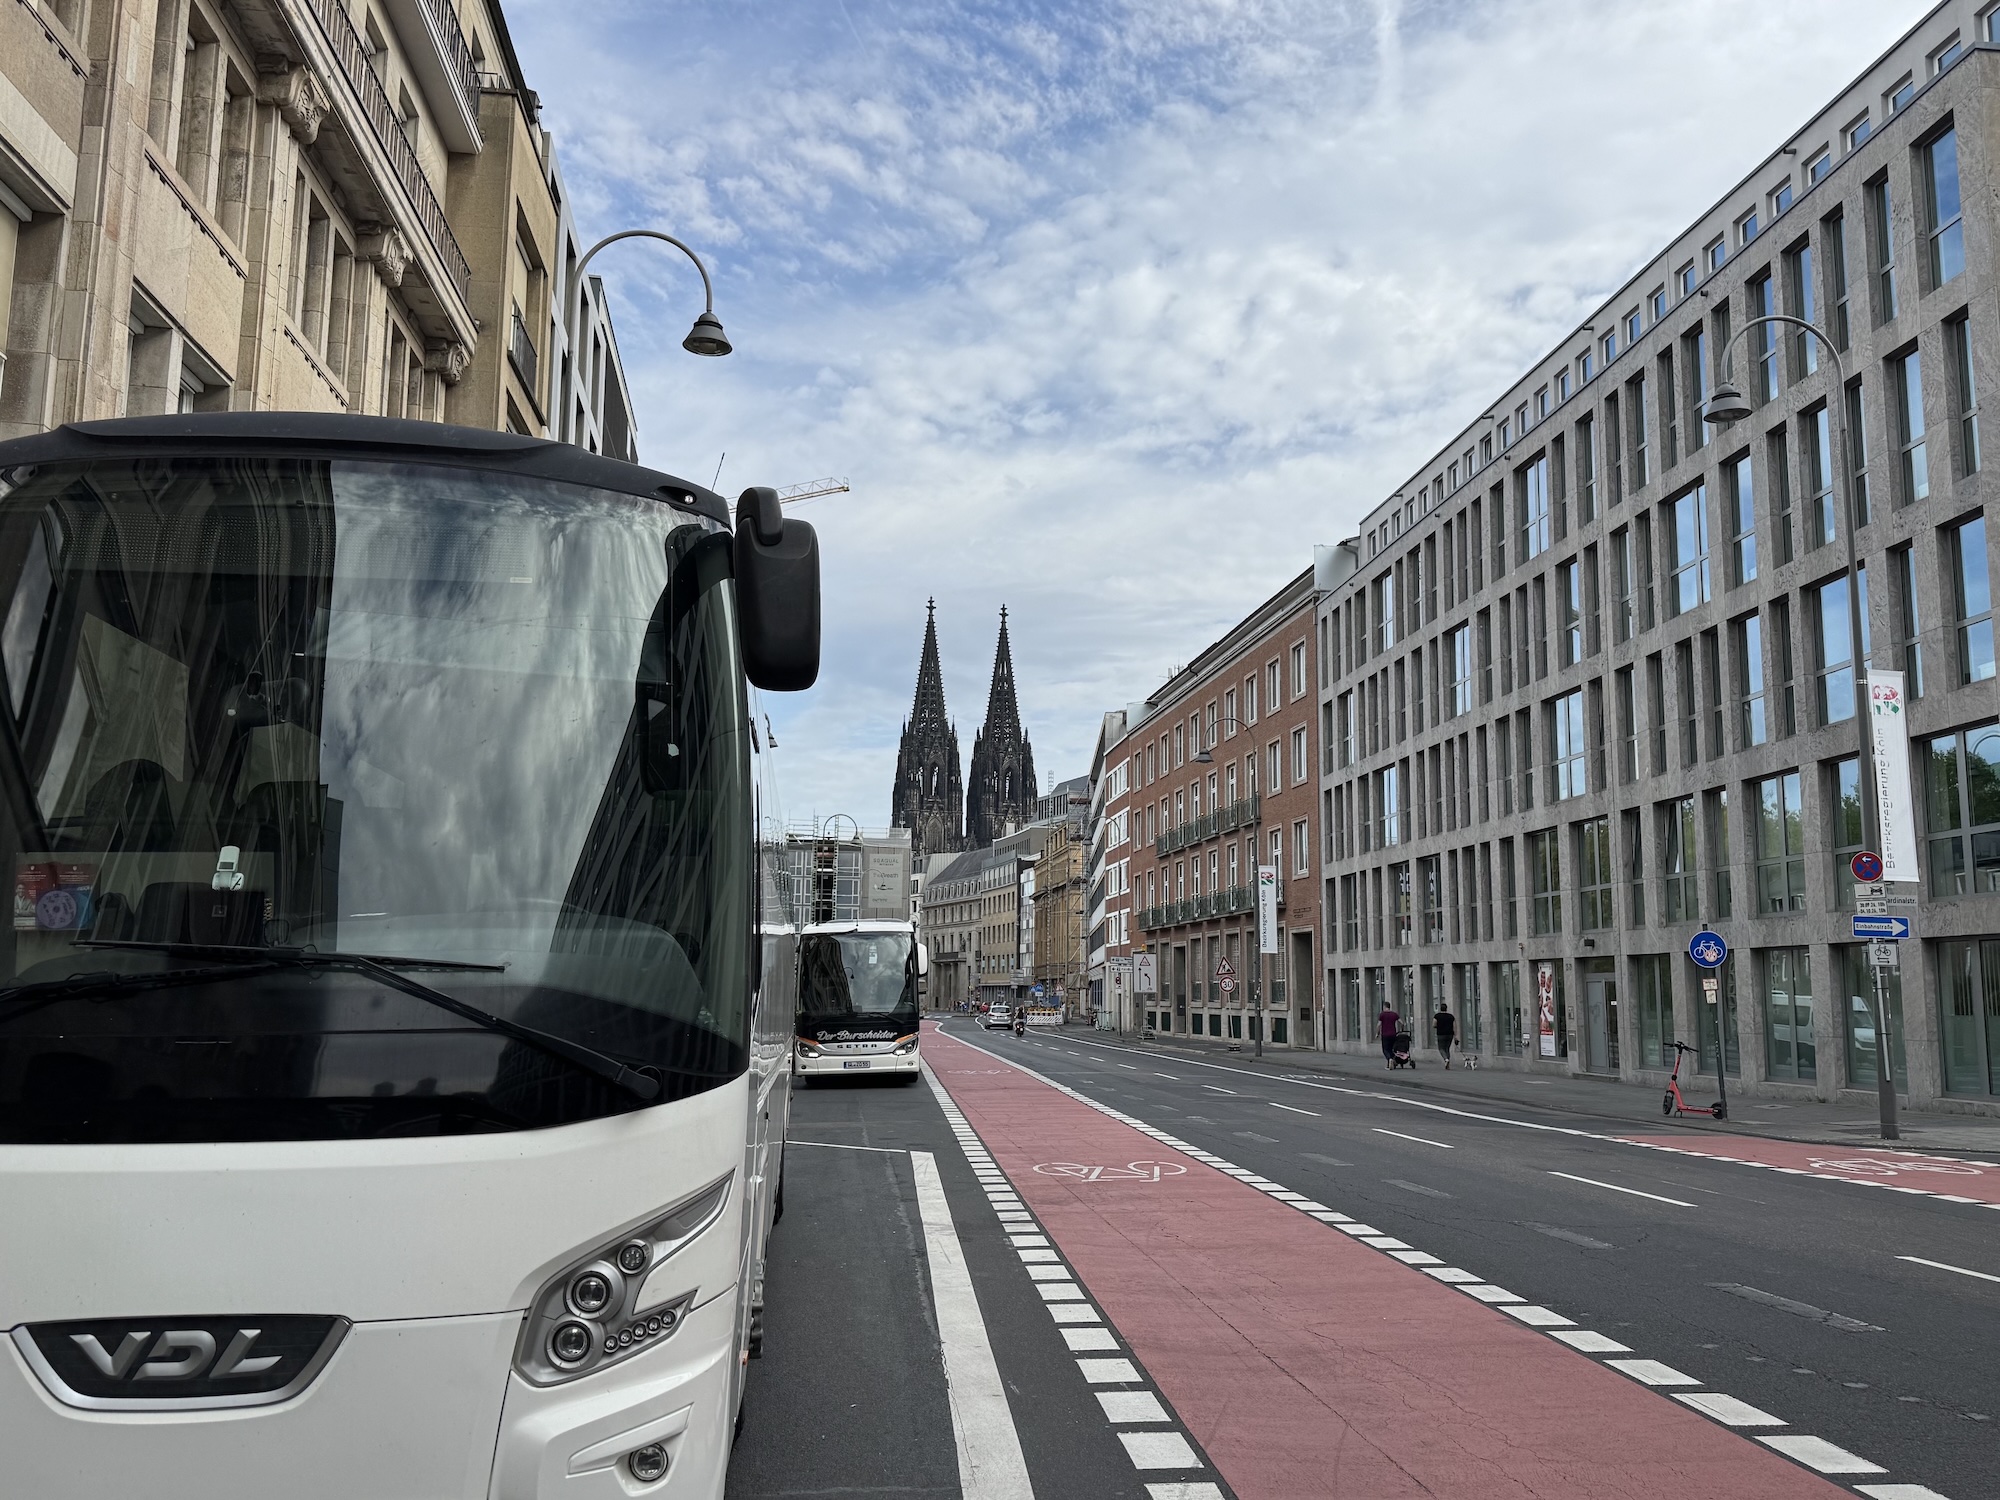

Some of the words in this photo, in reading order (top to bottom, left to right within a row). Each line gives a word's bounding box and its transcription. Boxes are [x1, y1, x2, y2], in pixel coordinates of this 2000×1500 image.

[1876, 727, 1886, 756] Köln
[1879, 759, 1896, 869] Bezirksregierung
[1222, 980, 1233, 989] 30
[816, 1030, 837, 1041] Der
[837, 1030, 898, 1041] Burscheider
[69, 1328, 285, 1382] VDL
